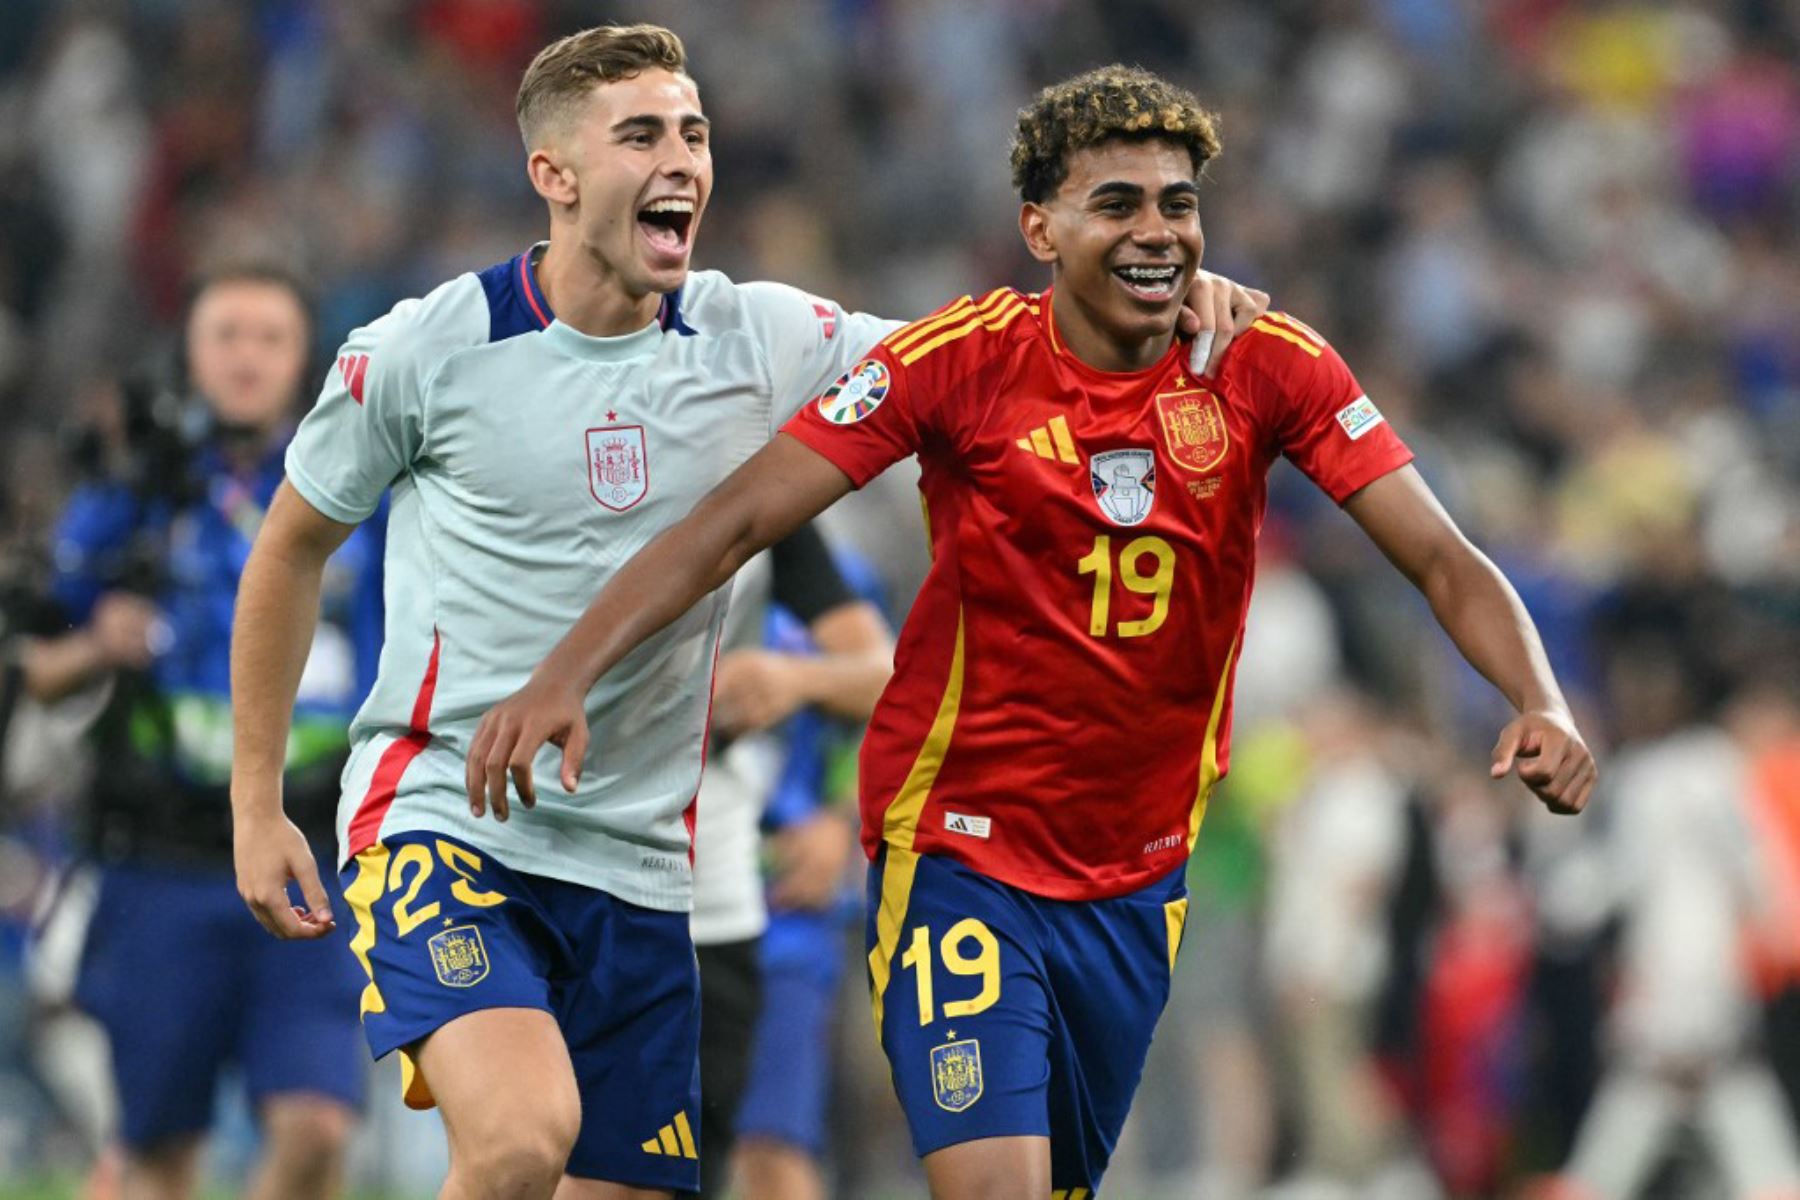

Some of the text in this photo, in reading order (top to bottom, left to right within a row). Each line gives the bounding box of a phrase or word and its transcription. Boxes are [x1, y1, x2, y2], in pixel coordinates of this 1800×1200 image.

[1078, 535, 1175, 637] 19
[388, 839, 507, 938] 25
[902, 917, 1000, 1026] 19
